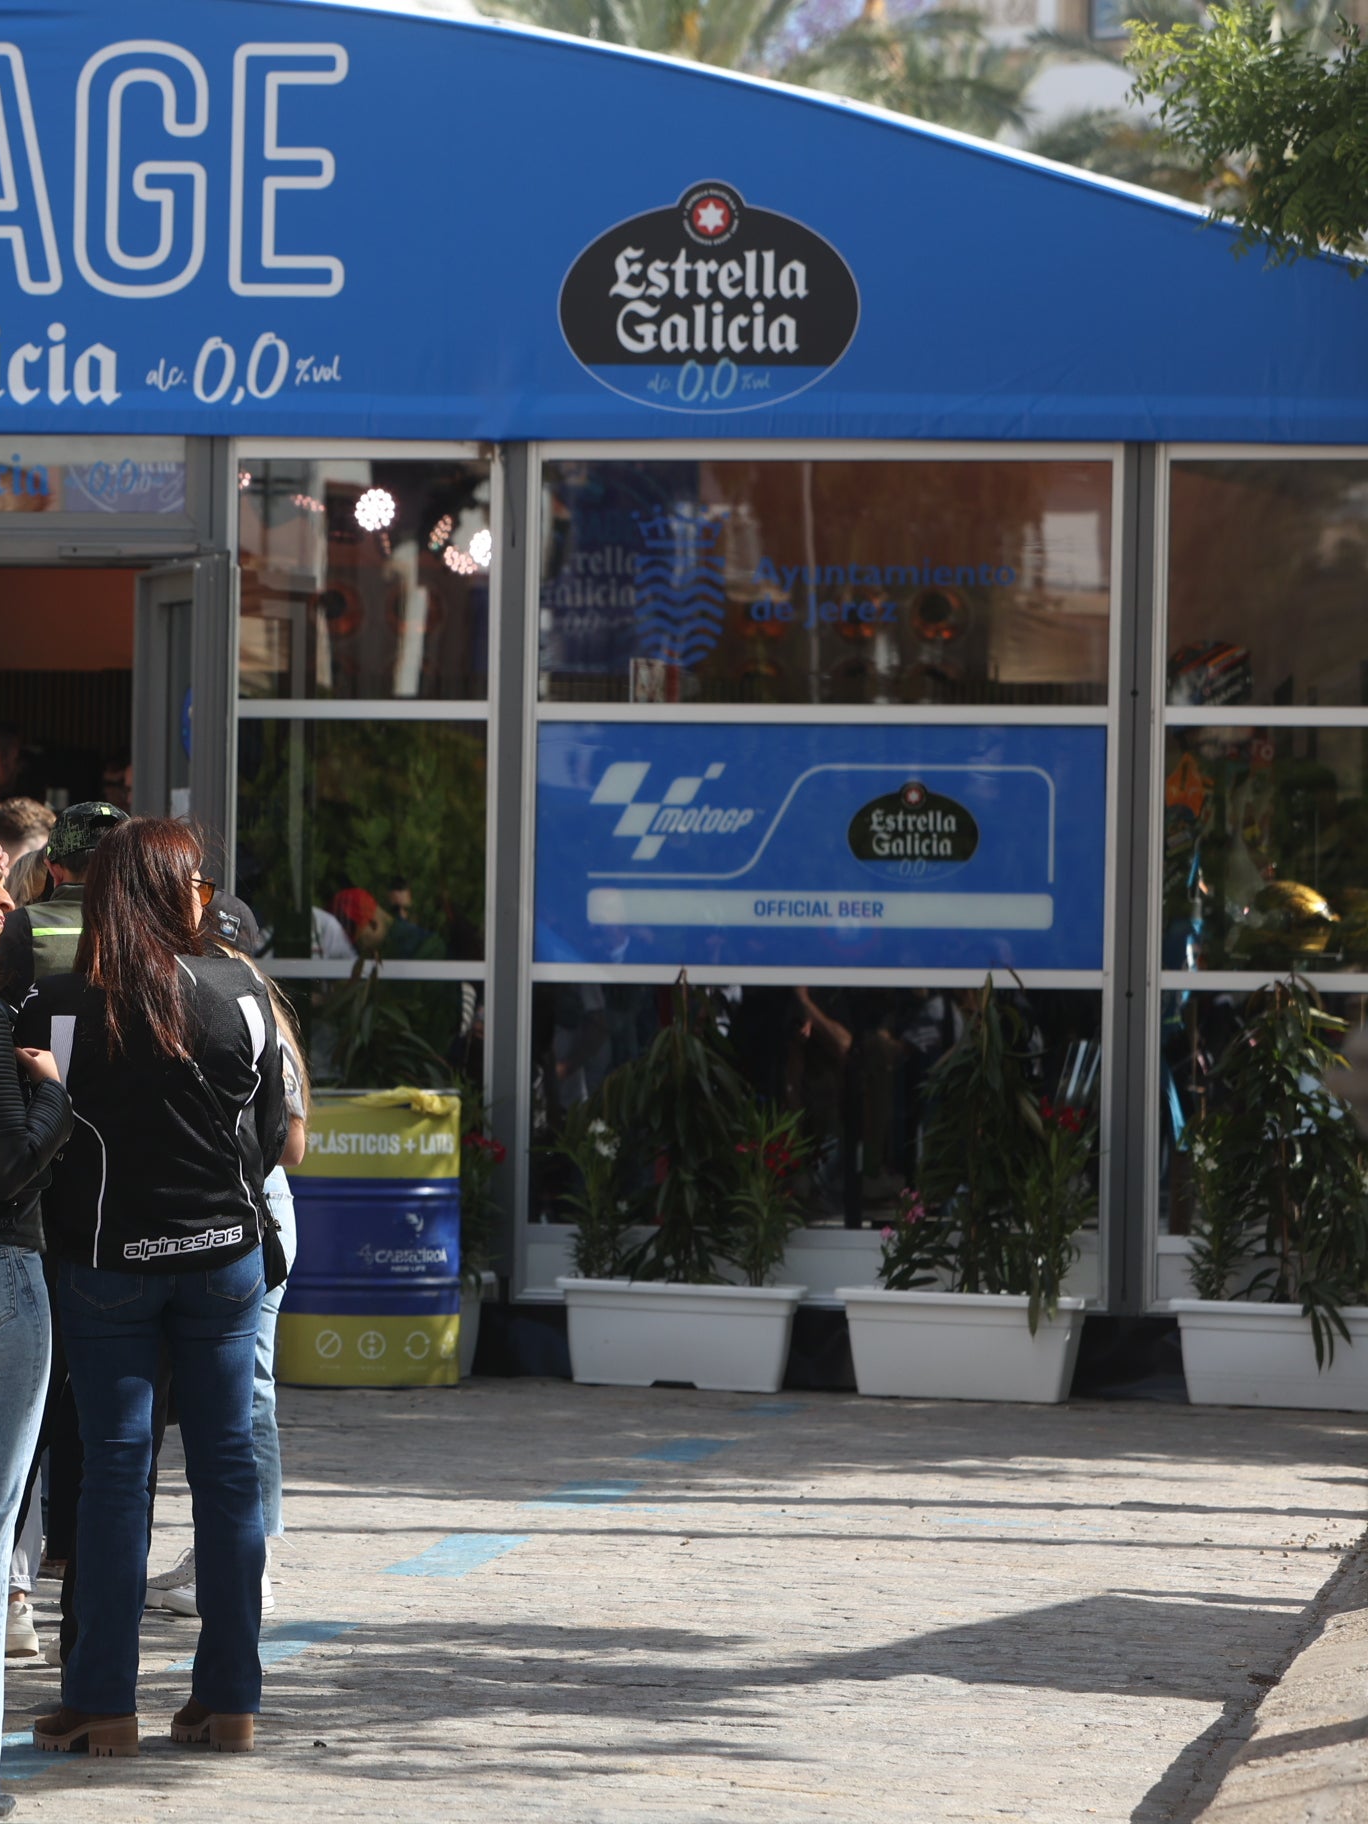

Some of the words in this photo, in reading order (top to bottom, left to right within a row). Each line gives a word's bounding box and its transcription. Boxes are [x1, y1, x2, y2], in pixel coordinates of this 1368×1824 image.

[609, 246, 809, 299] Estrella
[616, 300, 799, 354] Galicia
[193, 331, 289, 405] 0,0
[677, 357, 738, 403] 0,0
[751, 556, 1016, 592] Ayuntamiento
[750, 594, 794, 622] de
[804, 593, 898, 630] Jerez
[869, 808, 957, 832] Estrella
[873, 832, 952, 856] Galicia
[753, 899, 832, 917] OFFICIAL
[838, 901, 884, 918] BEER
[308, 1130, 400, 1155] PLÁSTICOS
[123, 1225, 243, 1261] alpinestars
